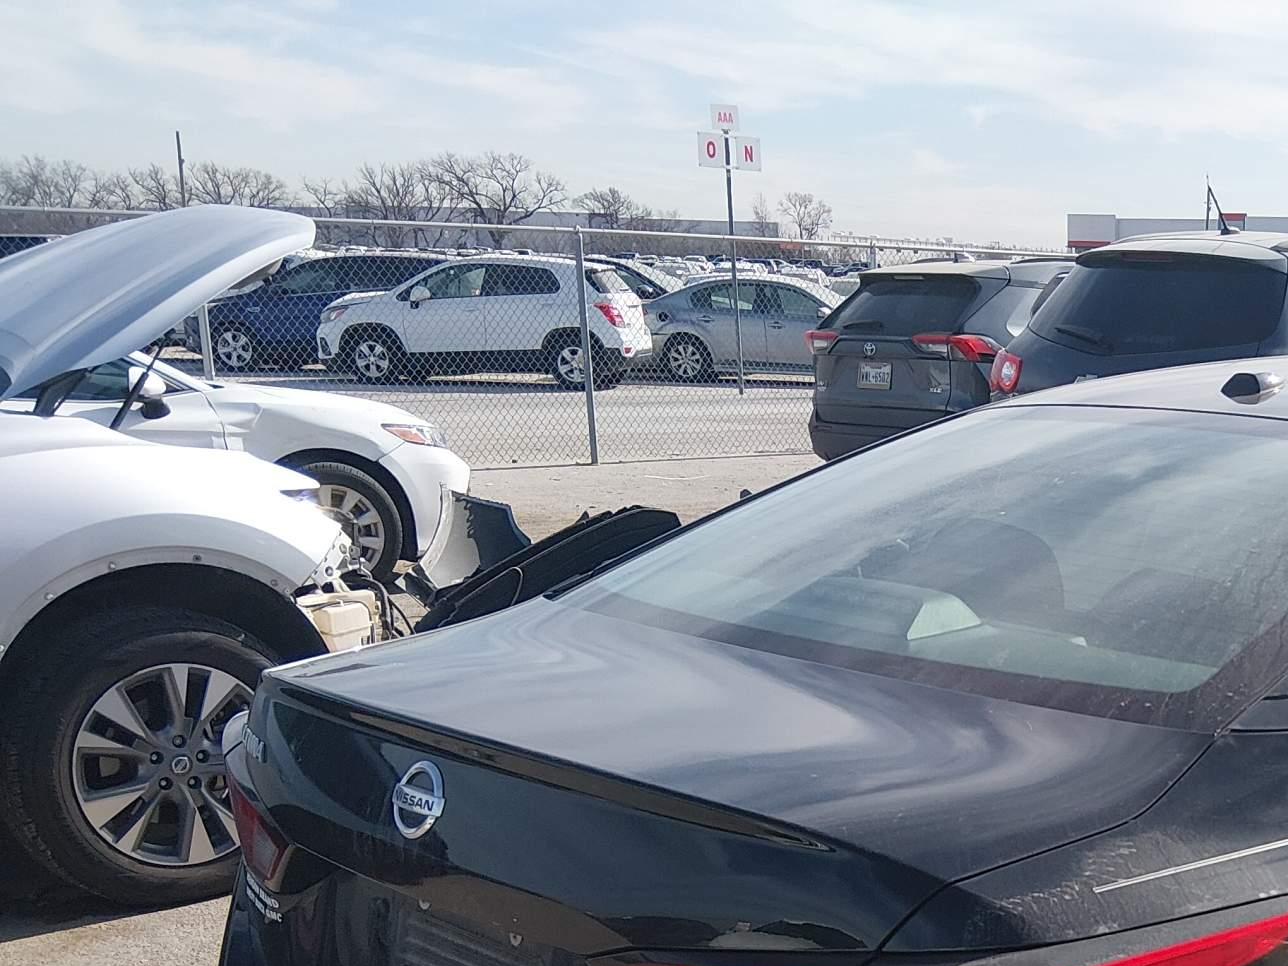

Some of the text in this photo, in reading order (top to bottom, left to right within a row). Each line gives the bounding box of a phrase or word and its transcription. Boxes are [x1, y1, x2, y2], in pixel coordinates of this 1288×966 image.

[717, 111, 733, 124] AAA
[706, 140, 716, 159] O
[744, 145, 753, 163] N
[395, 787, 435, 812] NISSAN
